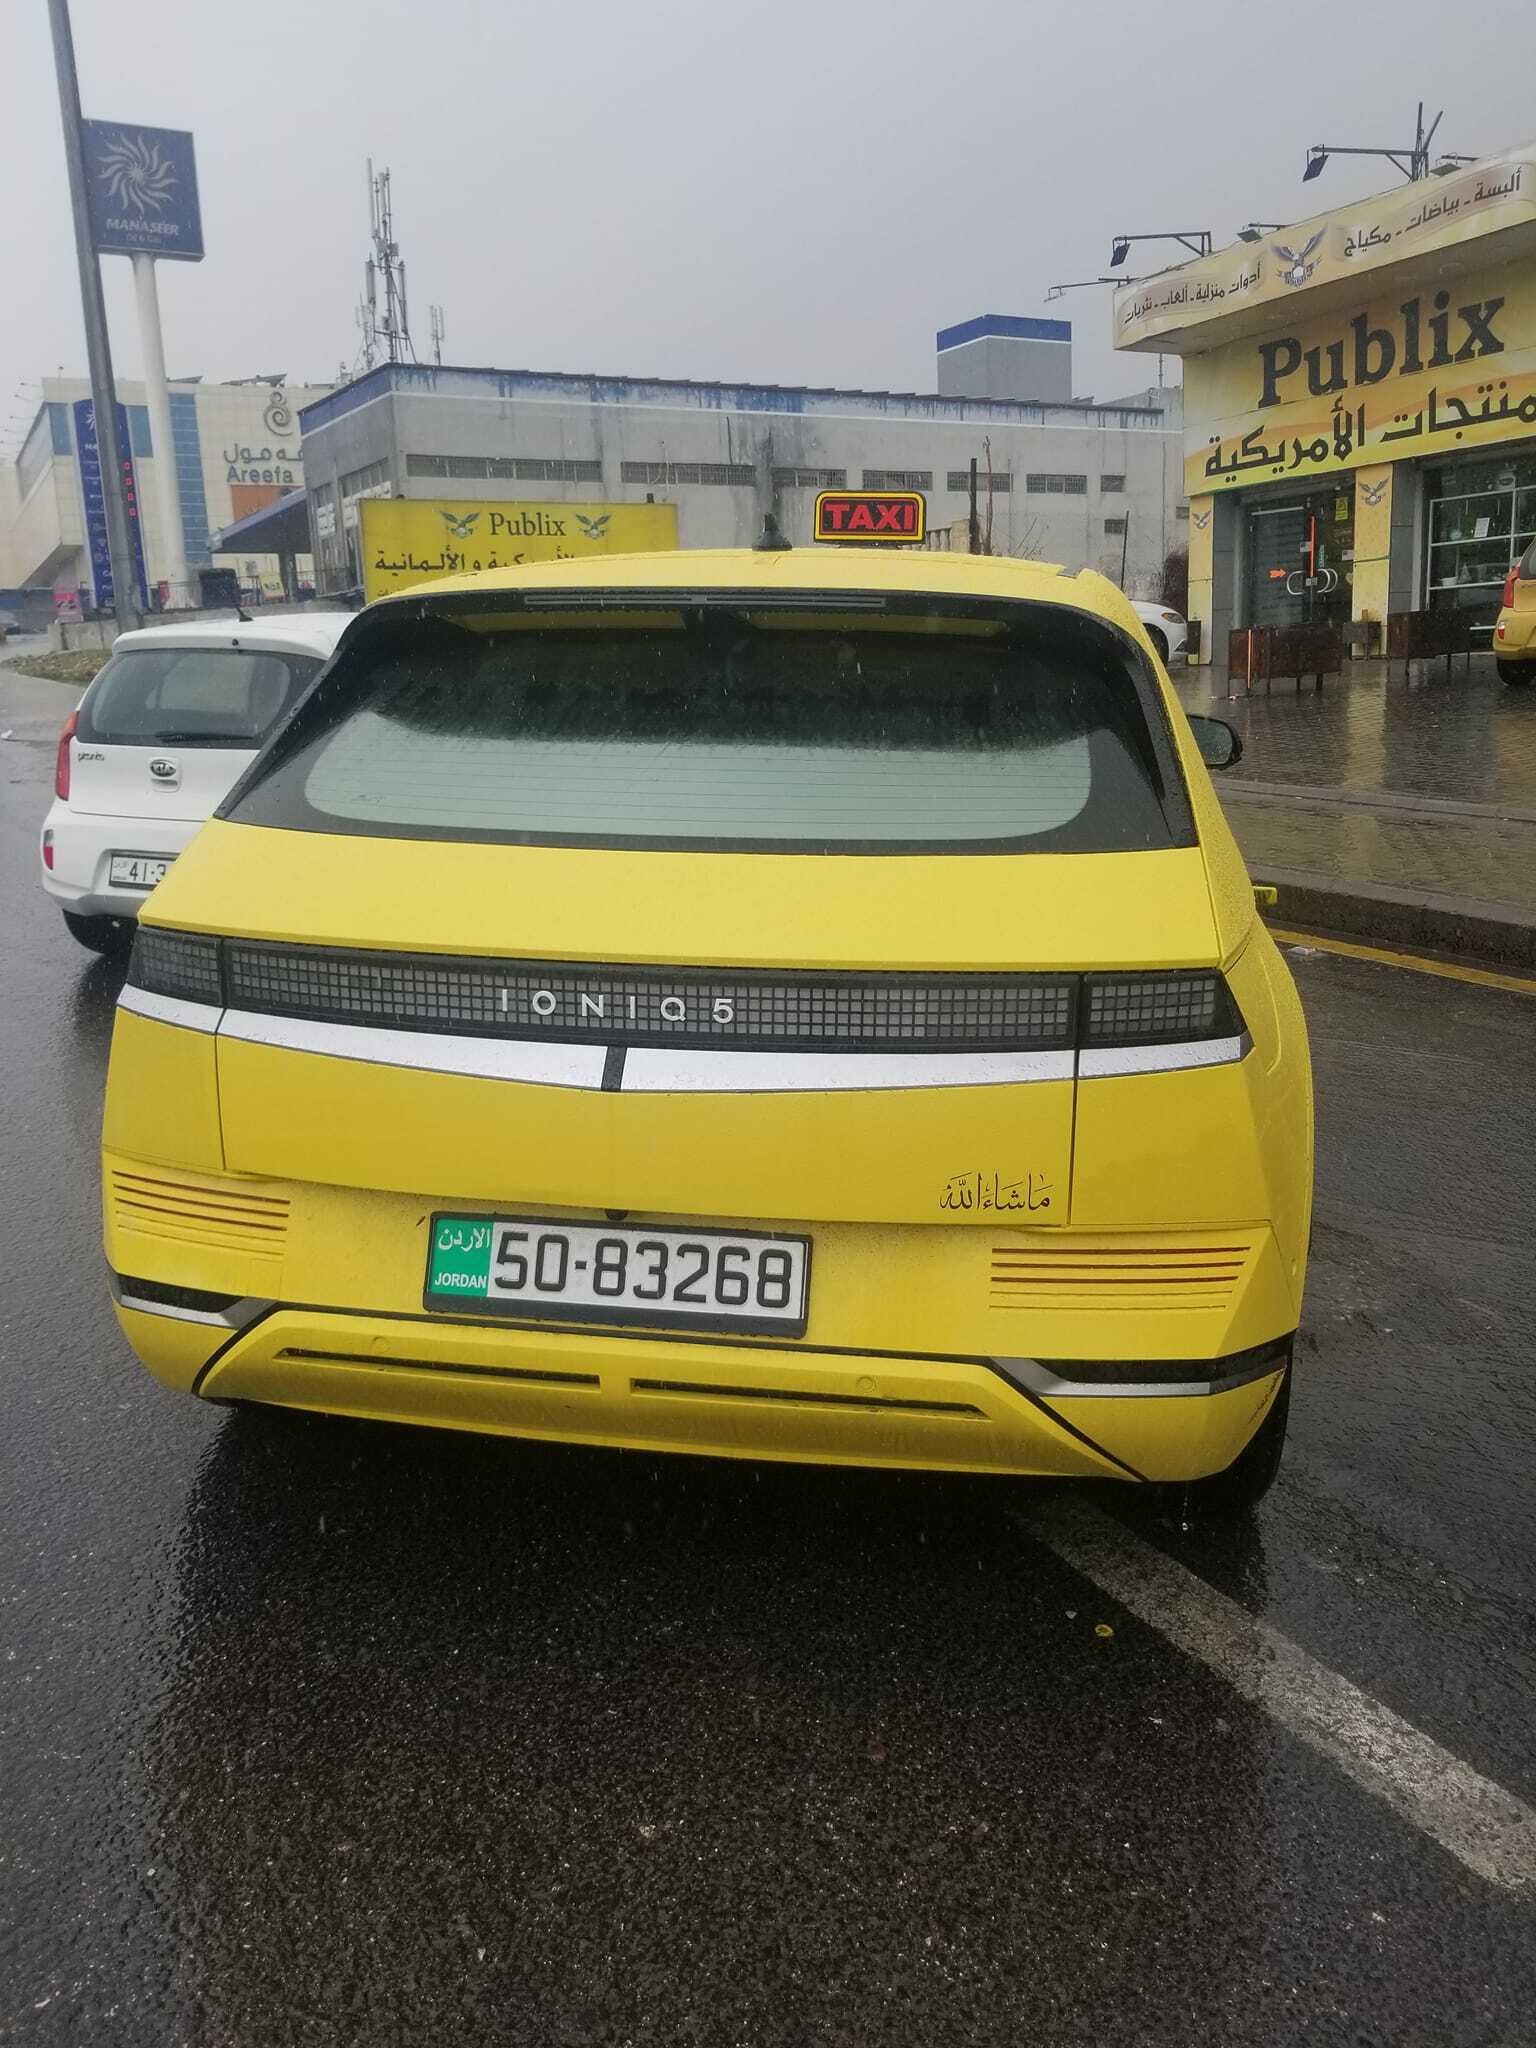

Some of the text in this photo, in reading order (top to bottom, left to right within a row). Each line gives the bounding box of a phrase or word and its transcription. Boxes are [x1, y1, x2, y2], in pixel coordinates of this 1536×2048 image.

[1474, 165, 1523, 200] ألبسة
[1405, 196, 1460, 232] بياضات
[1344, 225, 1392, 257] مكياج
[1195, 283, 1225, 304] منزلية
[1229, 261, 1262, 294] أدوات
[1257, 290, 1506, 409] Publix
[224, 443, 273, 464] مول
[1204, 395, 1366, 483] الأمريكية
[226, 465, 294, 483] Areefa
[489, 512, 567, 537] Publix
[825, 503, 914, 530] TAXI
[375, 545, 465, 576] الألمانية
[502, 988, 735, 1024] IONIQ 5
[434, 1272, 487, 1290] JORDAN
[494, 1230, 793, 1310] 50-83268
